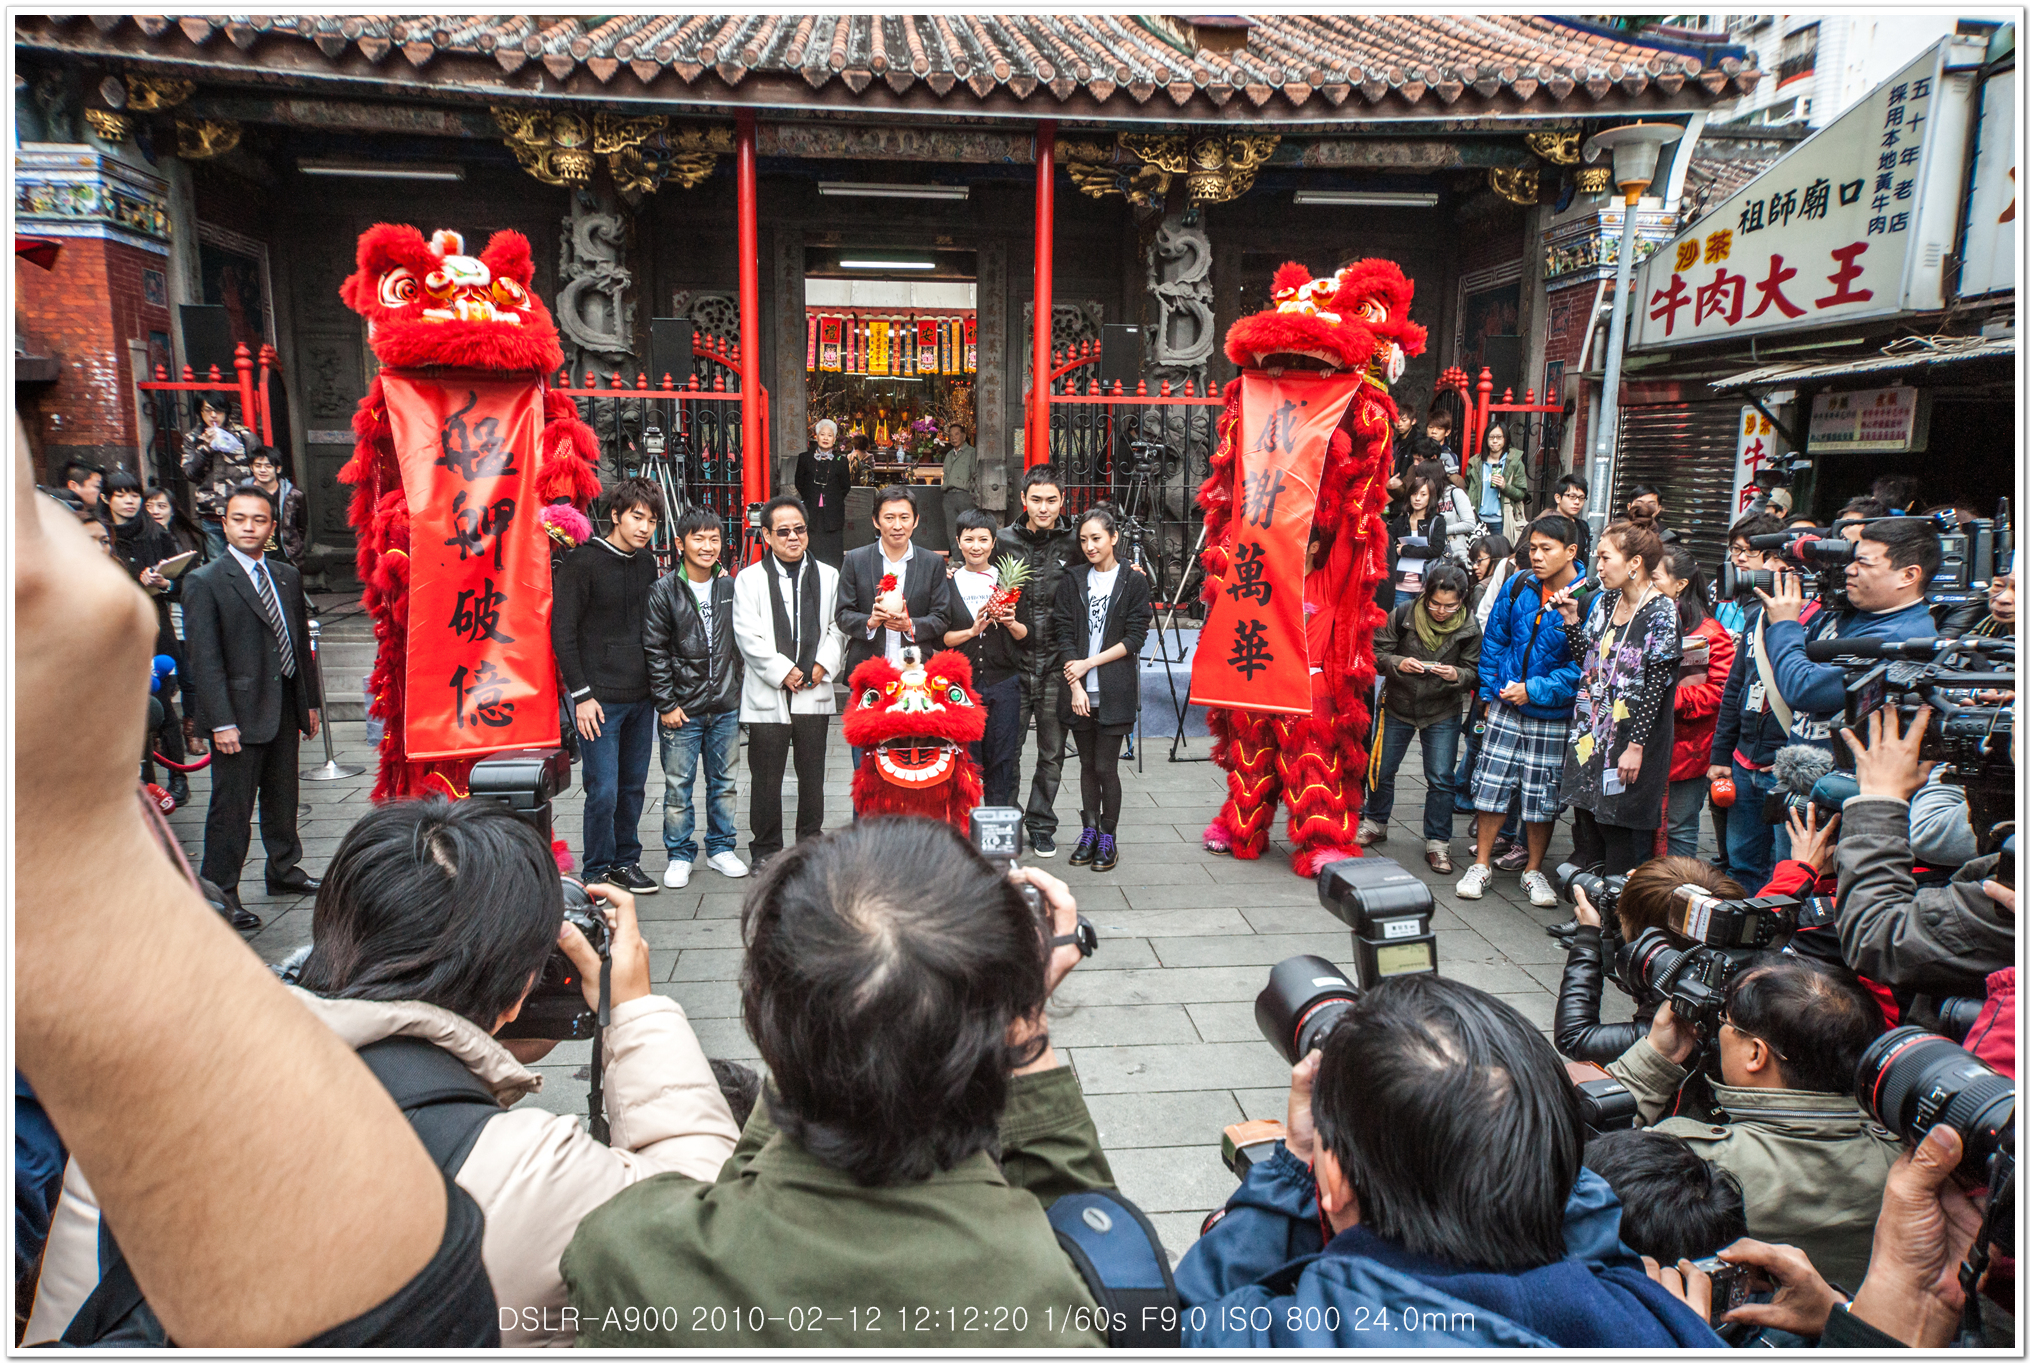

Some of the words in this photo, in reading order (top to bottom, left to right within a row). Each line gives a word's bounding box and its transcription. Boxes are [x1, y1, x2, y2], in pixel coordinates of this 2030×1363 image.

[1737, 178, 1866, 236] 祖師廟口
[1867, 82, 1909, 237] 採用本地黃牛肉
[1888, 76, 1933, 234] 五十年老店
[1650, 241, 1874, 337] 牛肉大王
[1675, 229, 1733, 273] 沙茶
[920, 326, 935, 343] 安
[434, 390, 519, 730] 艋舺破億
[1226, 399, 1308, 682] 感謝萬華
